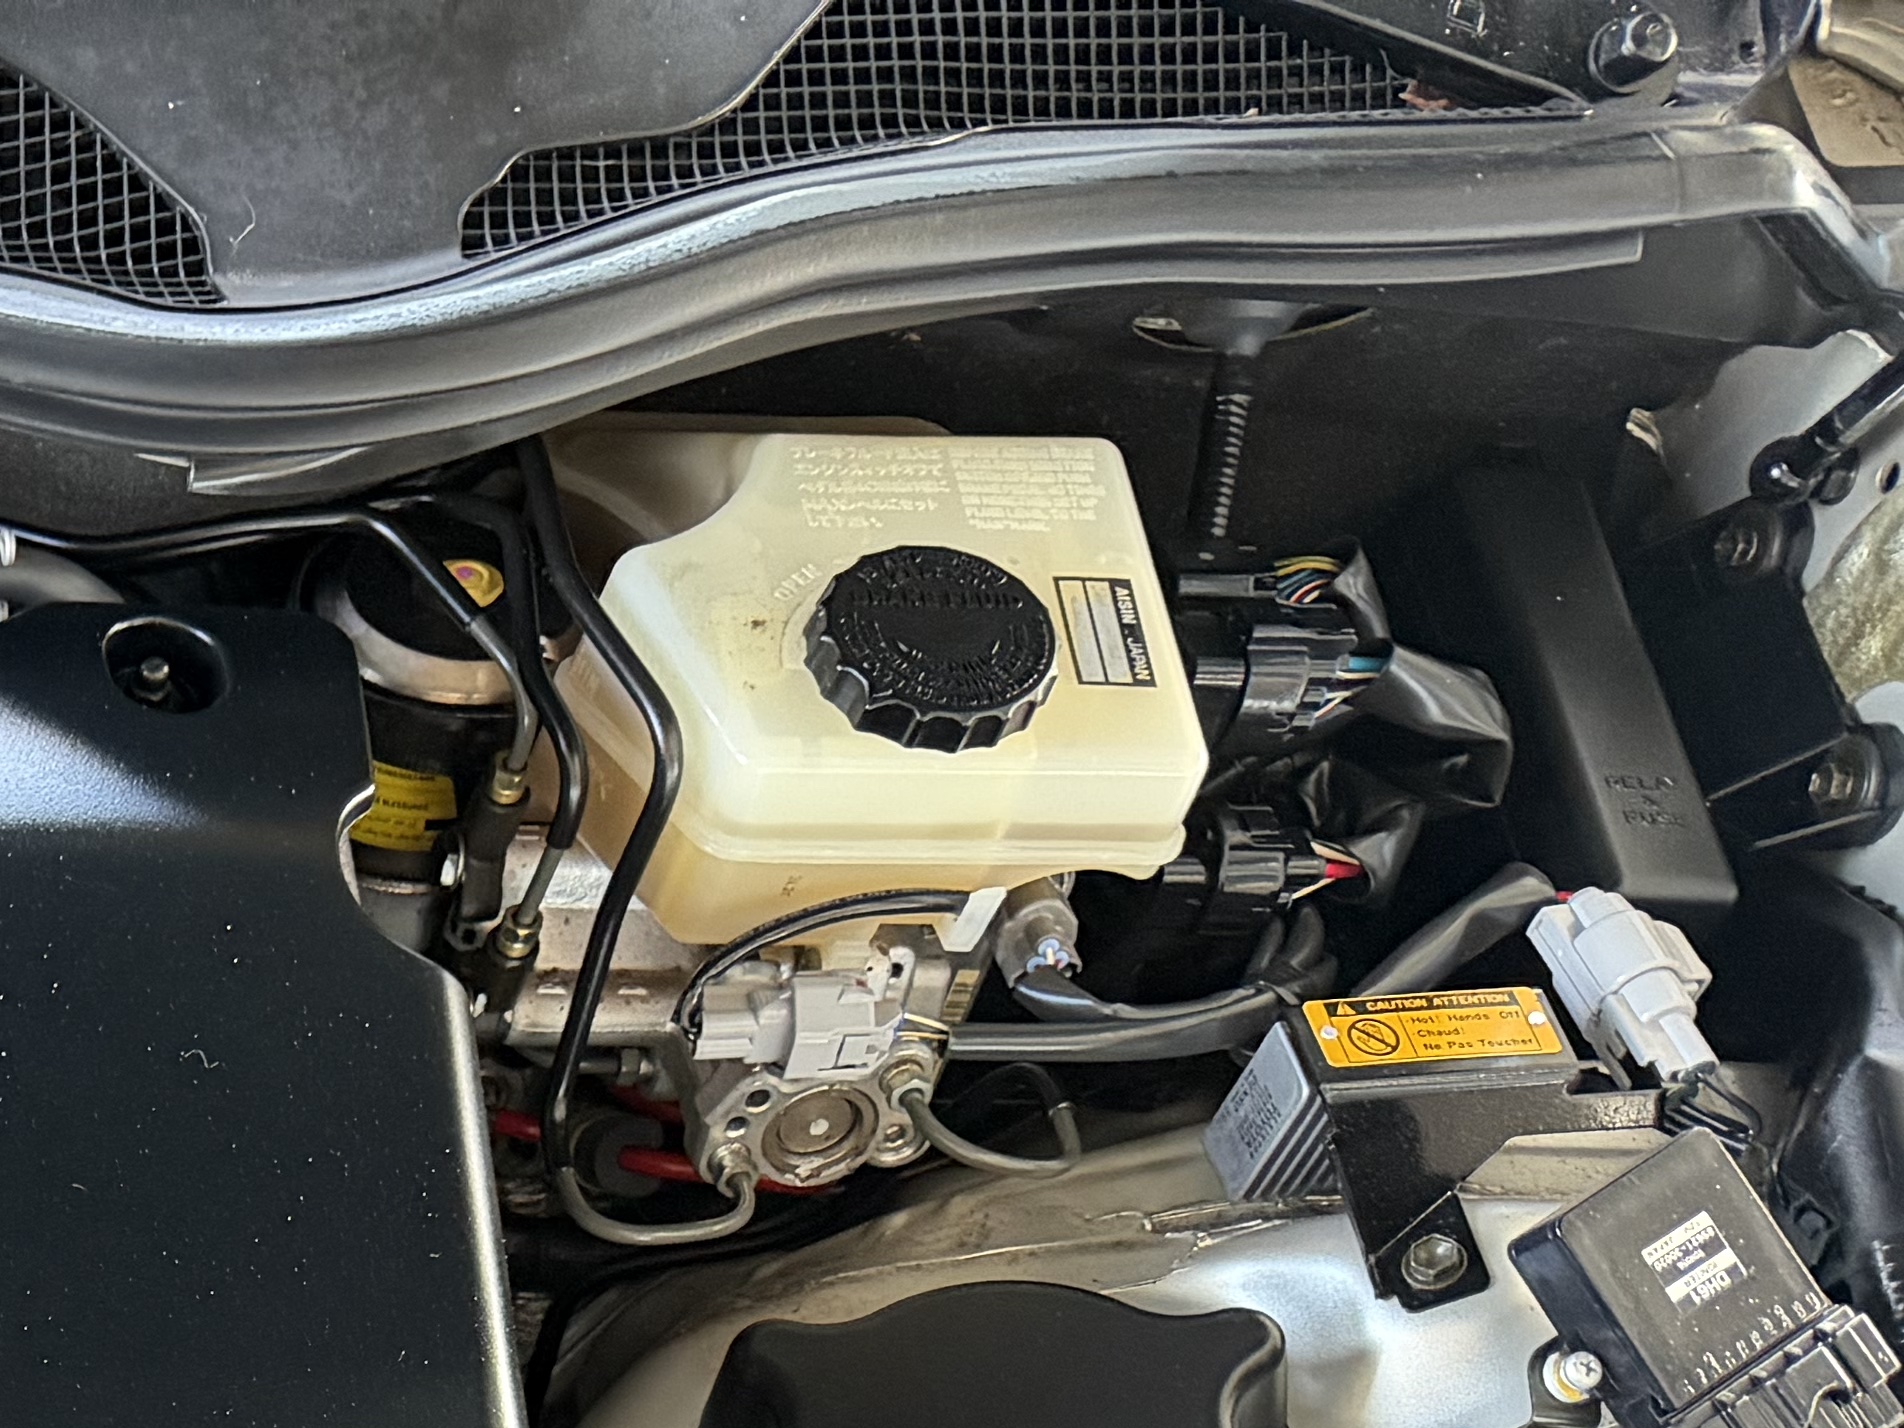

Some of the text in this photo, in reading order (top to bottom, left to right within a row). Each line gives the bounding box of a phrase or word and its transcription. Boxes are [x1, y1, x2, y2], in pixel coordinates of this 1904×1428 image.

[1110, 585, 1152, 681] AISIN JAPAN
[1366, 994, 1510, 1011] CAUTION ATTENTION
[1690, 1269, 1732, 1306] DH61
